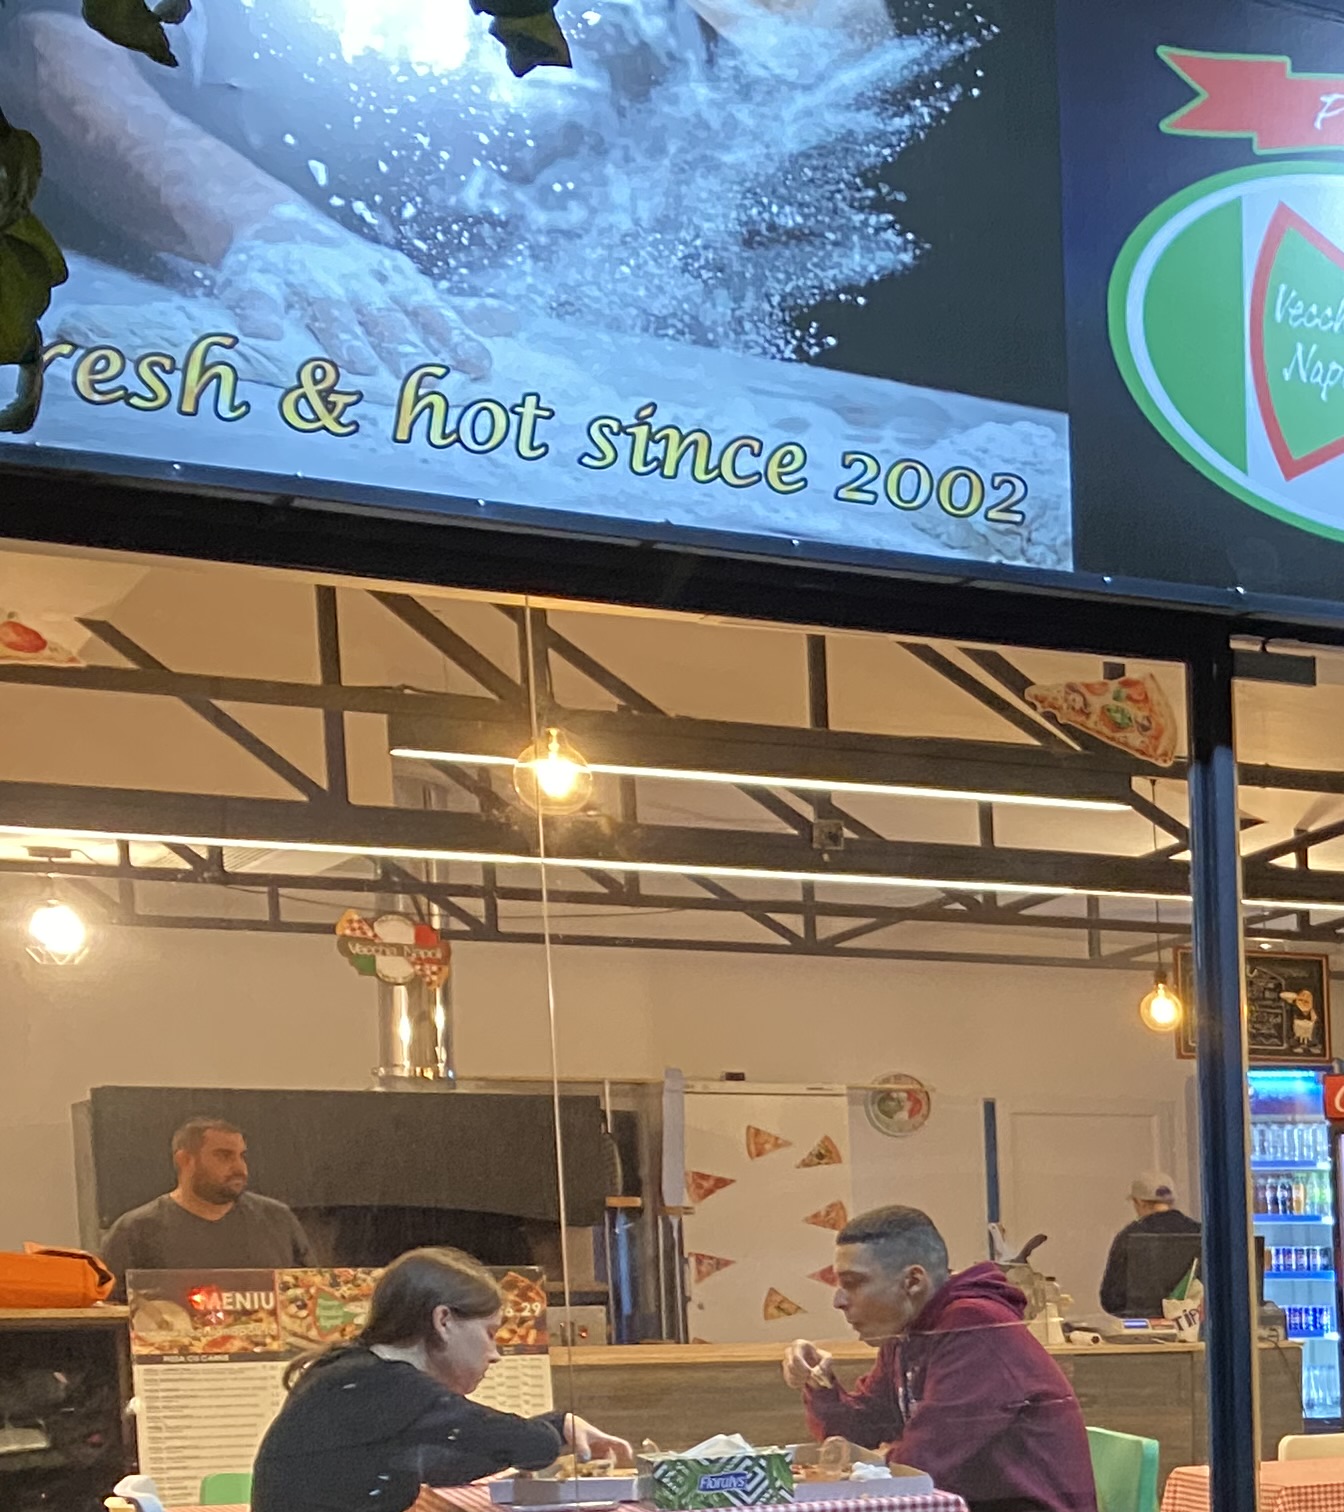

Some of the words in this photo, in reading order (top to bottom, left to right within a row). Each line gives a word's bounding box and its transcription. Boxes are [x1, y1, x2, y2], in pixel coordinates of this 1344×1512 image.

[279, 357, 360, 436] &
[393, 364, 552, 460] hot
[577, 405, 808, 494] since
[835, 450, 1029, 526] 2002
